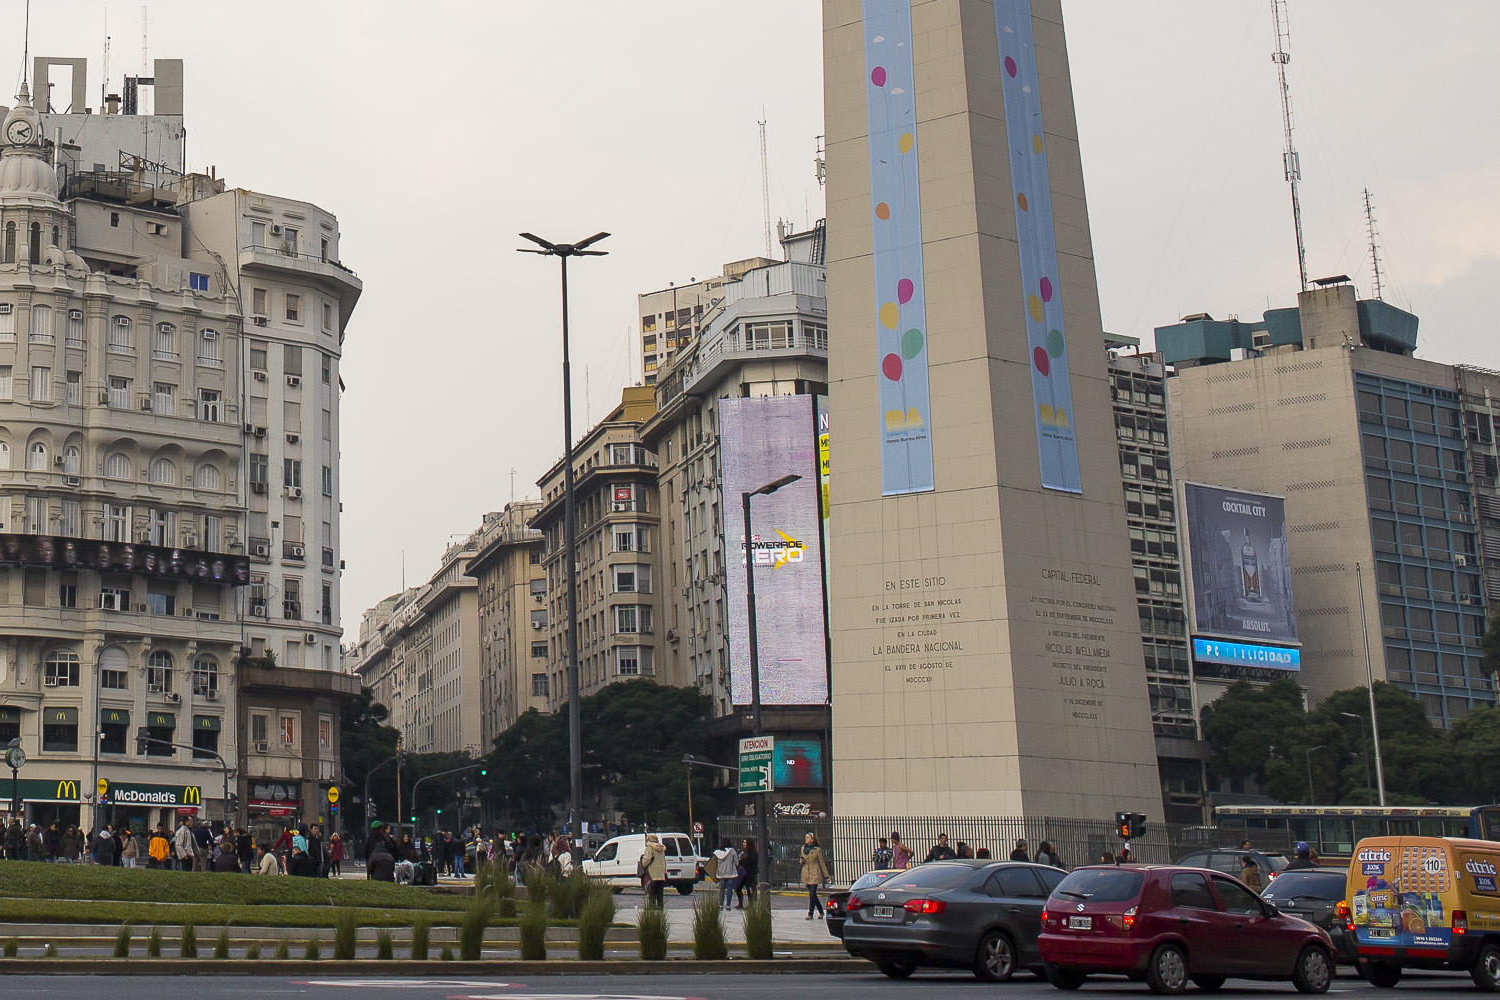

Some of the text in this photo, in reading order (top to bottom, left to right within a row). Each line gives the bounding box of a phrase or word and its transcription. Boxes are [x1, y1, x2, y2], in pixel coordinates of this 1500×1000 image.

[1222, 501, 1266, 517] COCKTAIL CITY
[886, 577, 946, 590] EN ESTE SITIO
[1041, 568, 1101, 586] CAPITAL FEDERAL
[873, 641, 963, 655] LA BANDERA NACIONAL
[1086, 678, 1106, 689] ROCA
[744, 739, 768, 749] ATENCION
[114, 788, 176, 803] McDonald's
[1358, 848, 1391, 861] citric
[1426, 860, 1439, 871] 110
[1465, 858, 1497, 875] citric
[1371, 893, 1388, 902] citric
